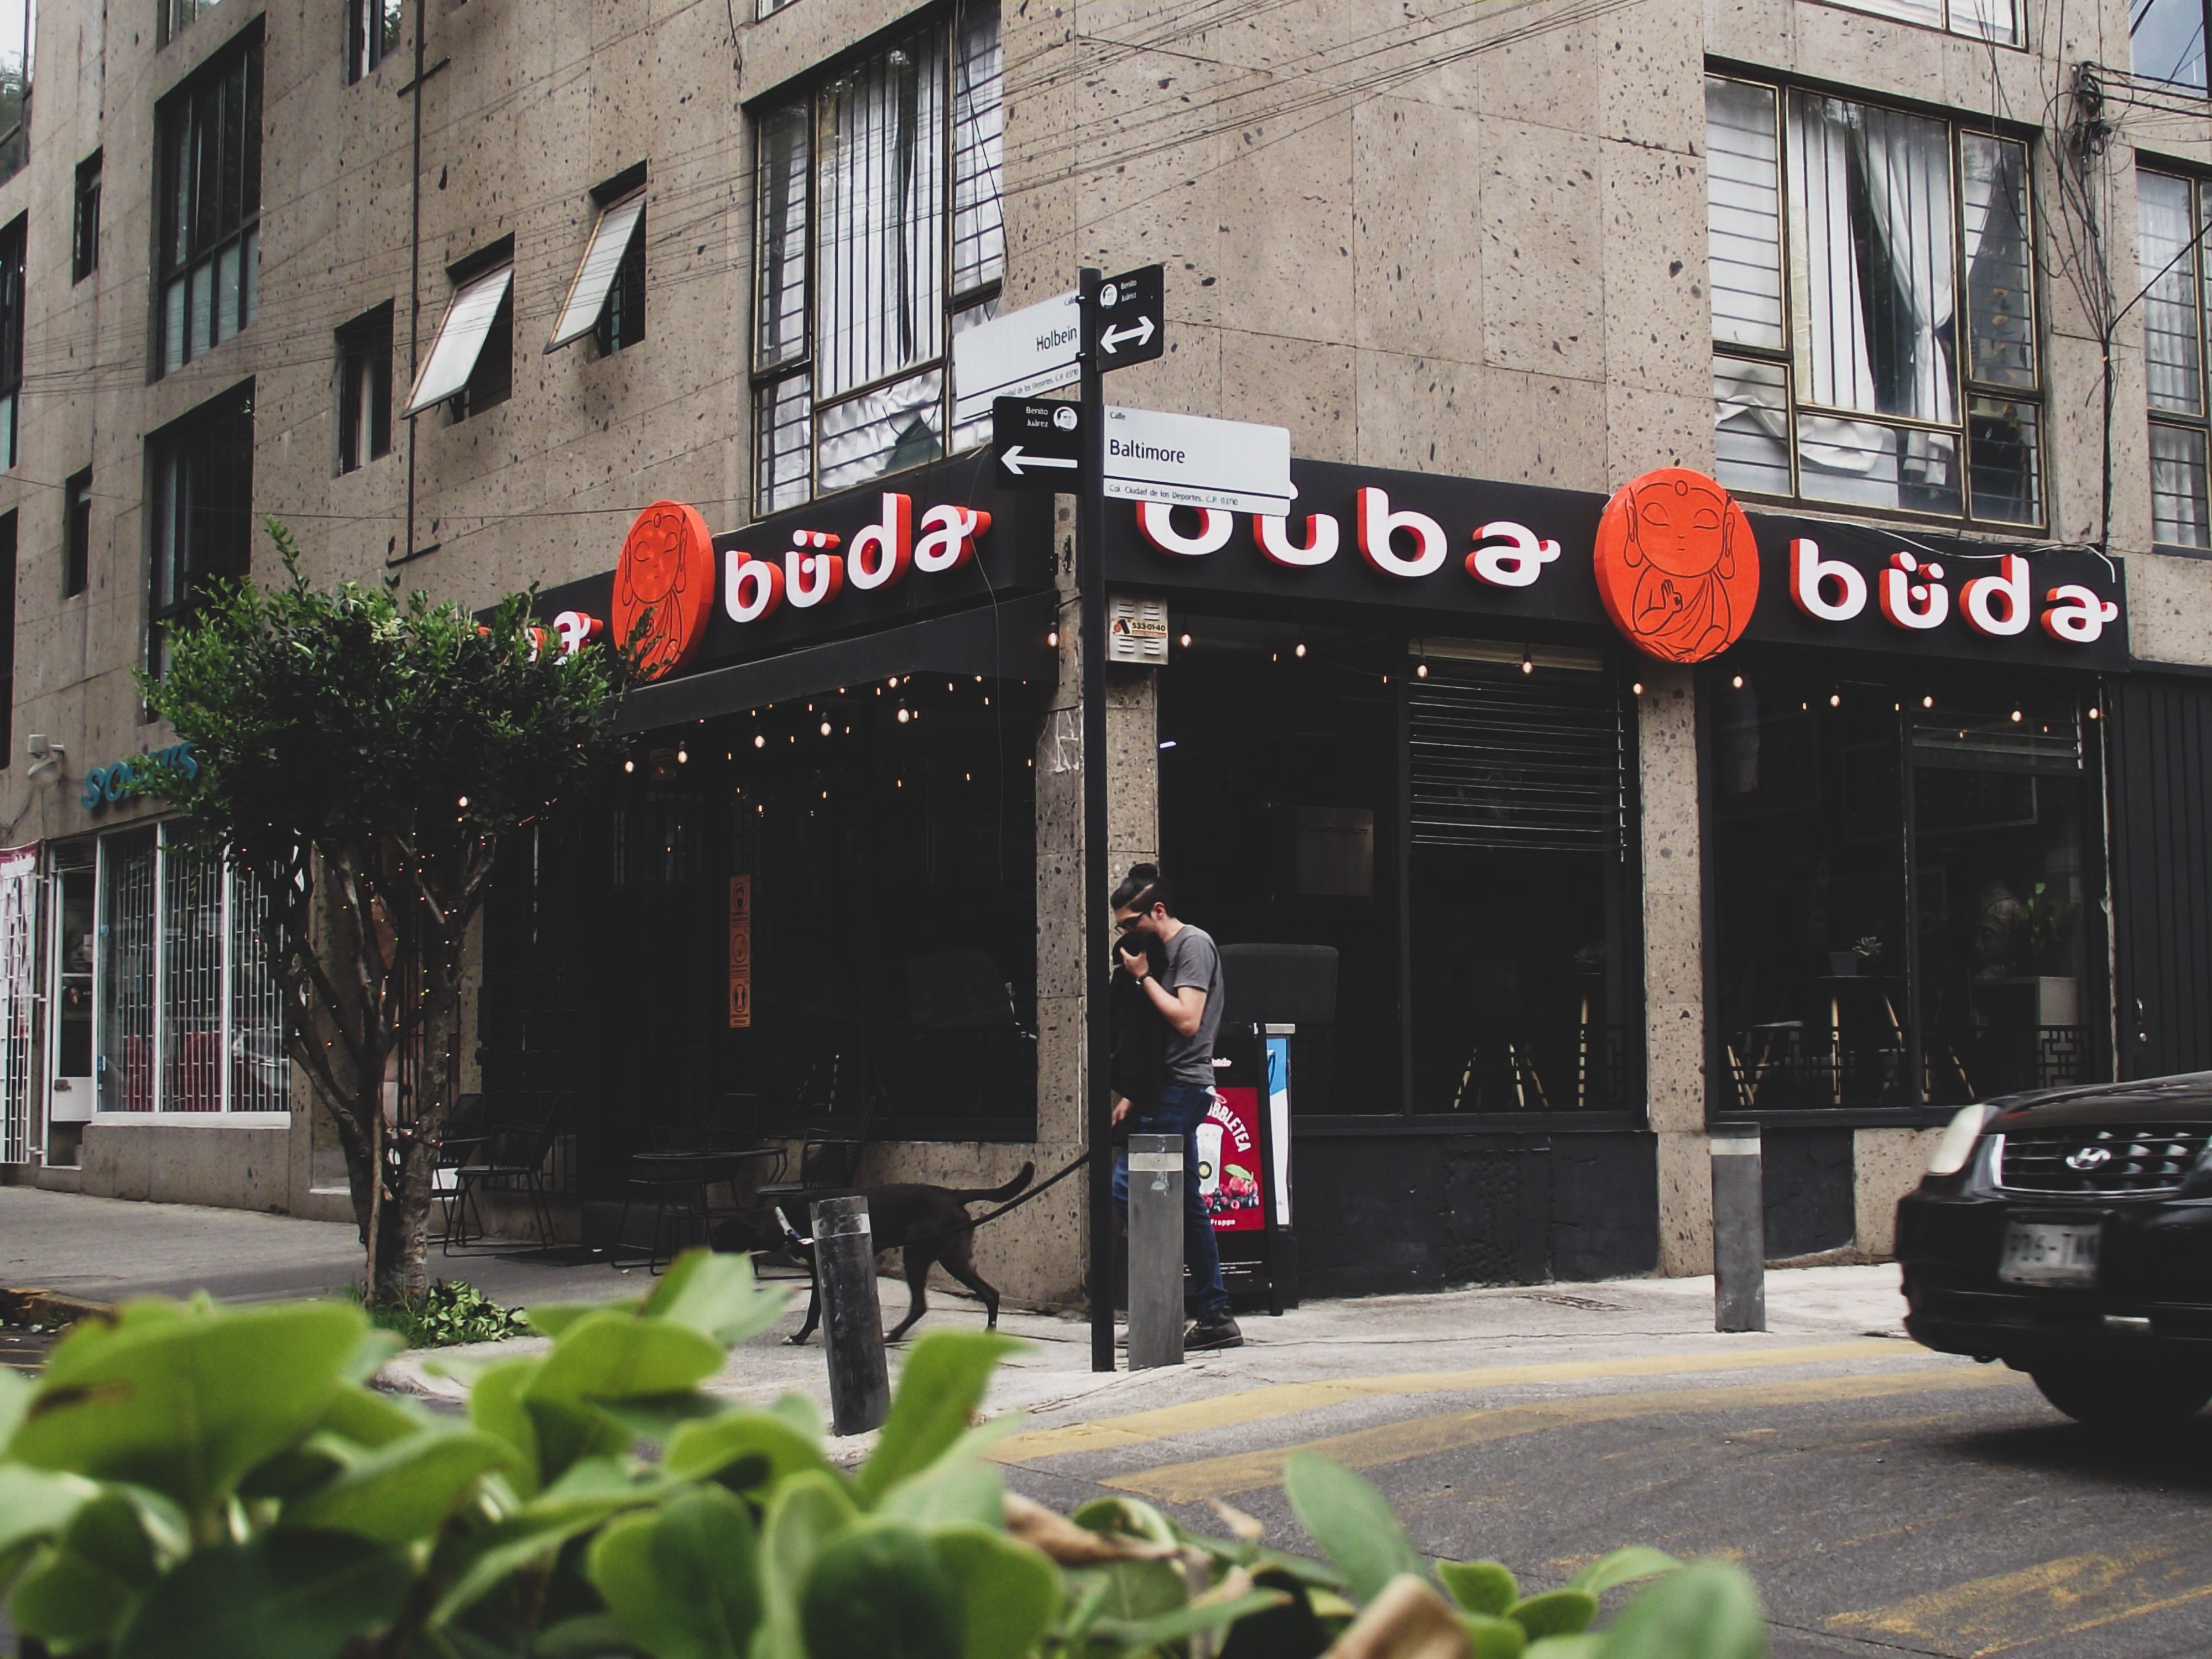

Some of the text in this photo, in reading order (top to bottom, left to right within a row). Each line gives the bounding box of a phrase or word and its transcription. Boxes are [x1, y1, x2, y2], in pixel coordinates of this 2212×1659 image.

[1036, 326, 1077, 352] Holbein
[1026, 406, 1048, 415] Benito
[1110, 439, 1185, 463] Baltimore
[1125, 486, 1147, 495] Ciudad
[726, 492, 991, 623] büda
[1790, 538, 2124, 643] büda
